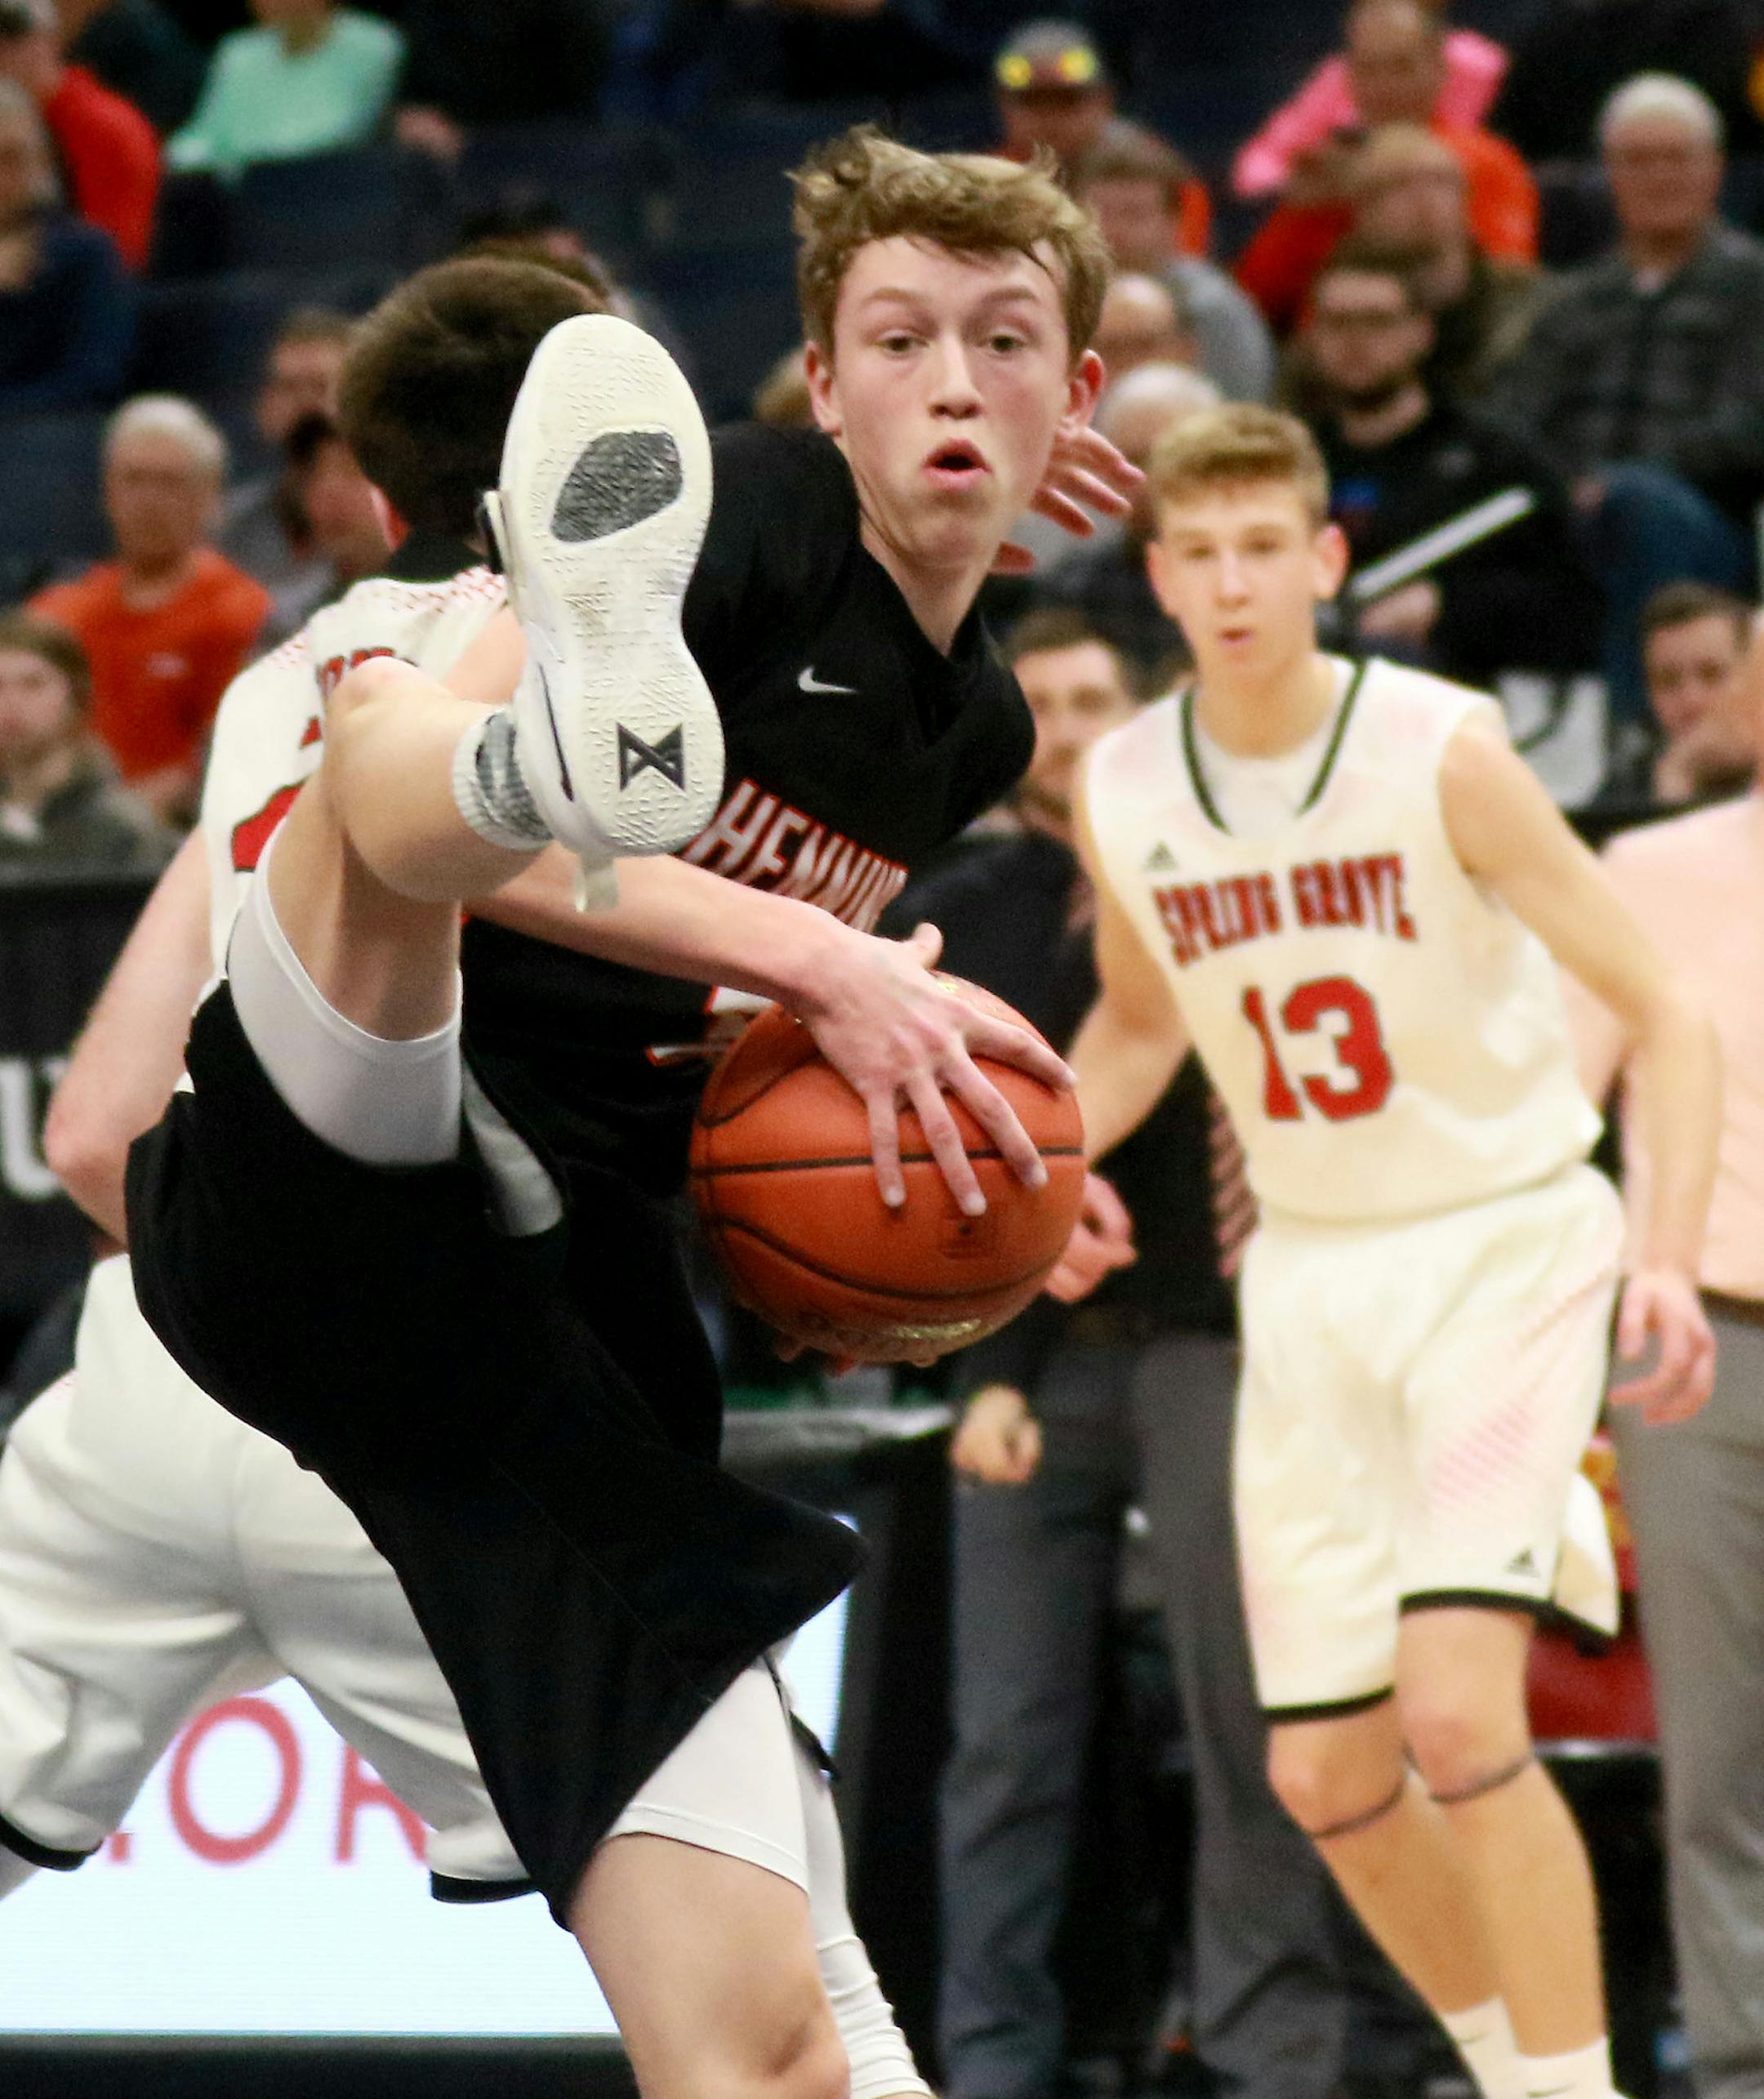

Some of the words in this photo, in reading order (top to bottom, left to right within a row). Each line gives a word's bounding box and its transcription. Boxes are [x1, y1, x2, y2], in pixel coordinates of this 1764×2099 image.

[1152, 871, 1285, 969] SPRING
[1290, 851, 1419, 943] GROVE
[1241, 974, 1394, 1123] 13
